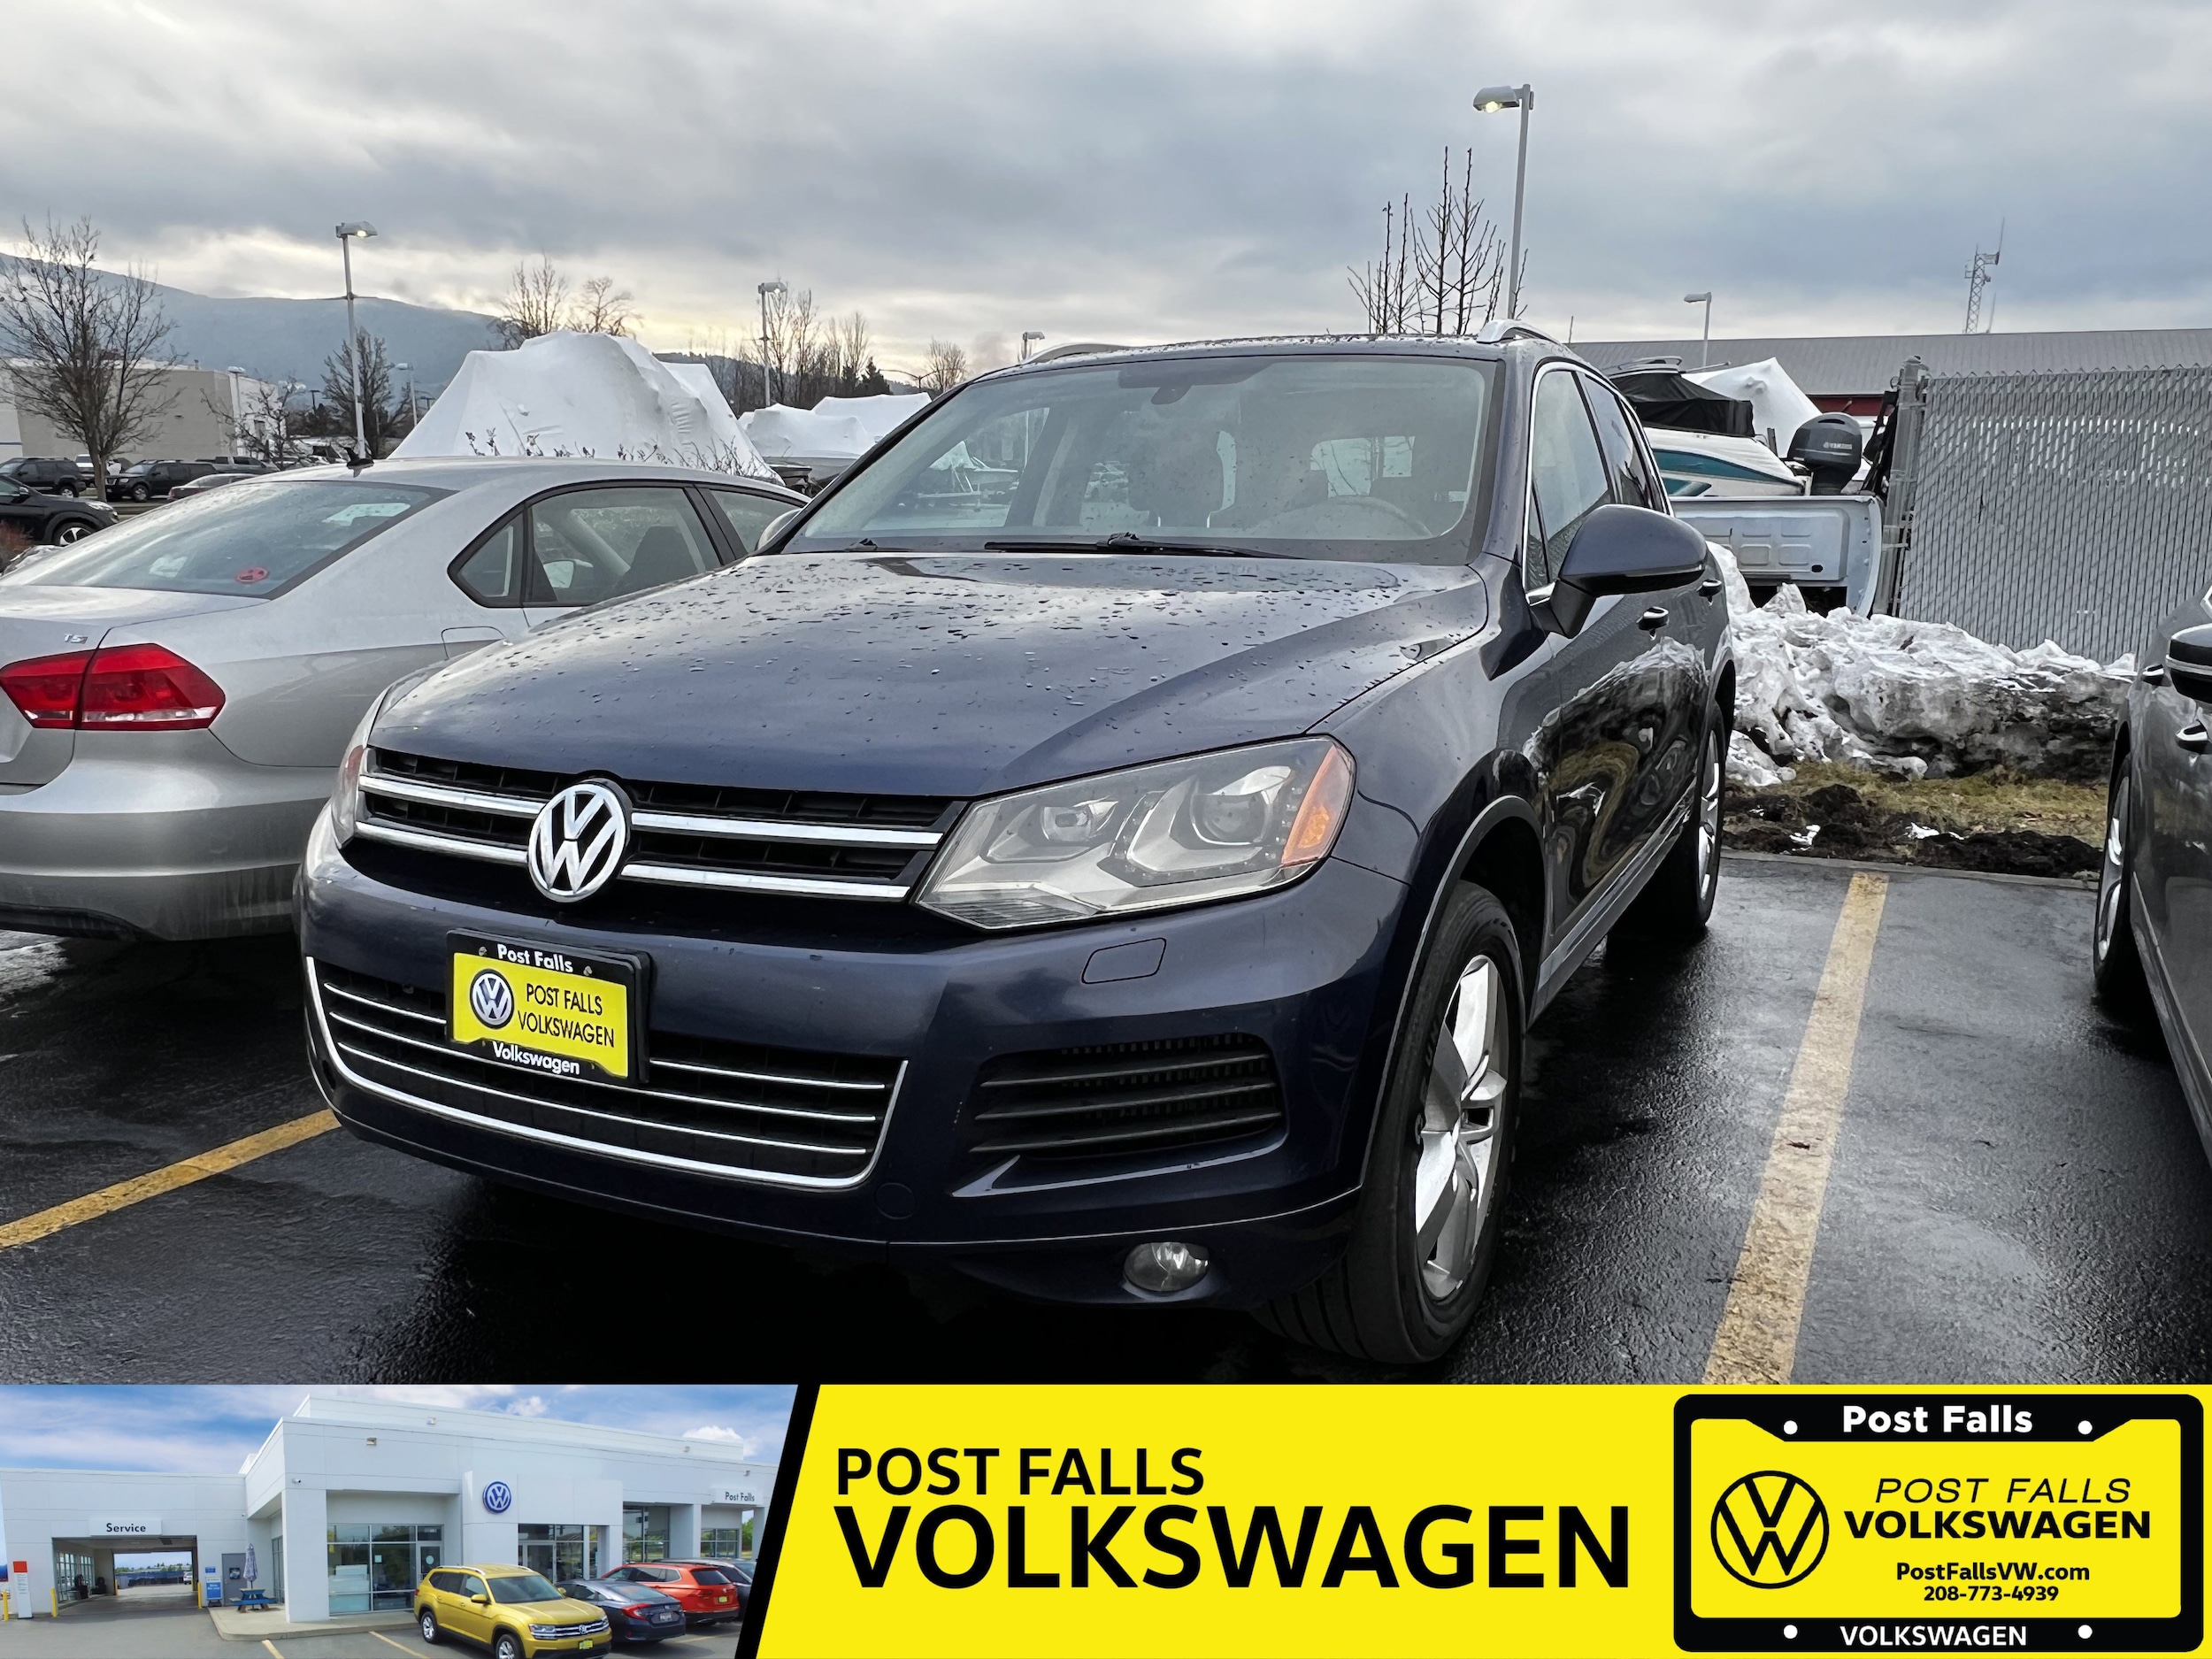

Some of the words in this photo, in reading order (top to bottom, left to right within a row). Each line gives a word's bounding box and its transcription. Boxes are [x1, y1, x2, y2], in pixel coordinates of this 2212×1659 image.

[496, 943, 530, 965] Post
[534, 950, 573, 972] Falls
[526, 983, 559, 1008] POST
[565, 990, 603, 1016] FALLS
[518, 1010, 615, 1048] VOLKSWAGEN
[492, 1041, 580, 1075] Volkswagen
